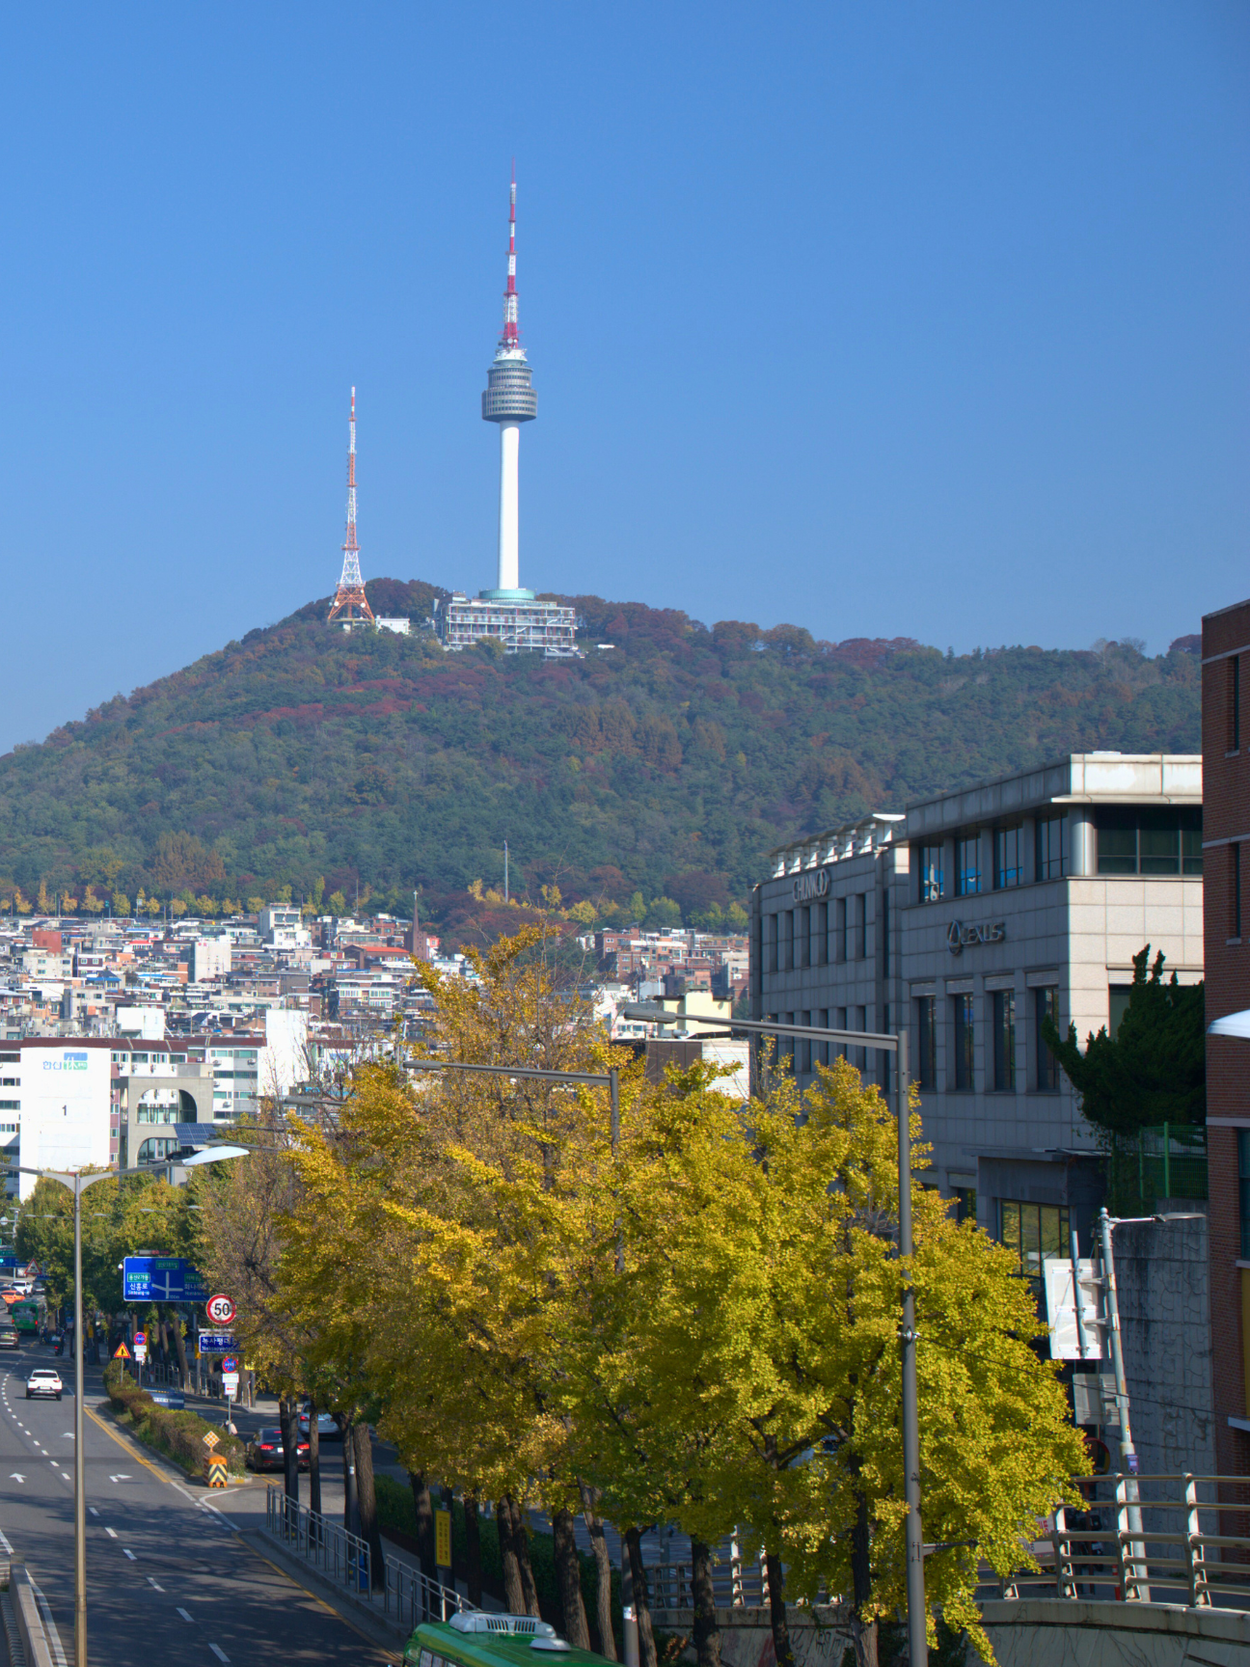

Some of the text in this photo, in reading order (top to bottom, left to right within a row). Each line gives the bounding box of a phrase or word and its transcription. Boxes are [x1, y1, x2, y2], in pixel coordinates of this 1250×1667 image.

[961, 923, 1004, 945] LEXUS
[43, 1061, 62, 1070] 한신
[62, 1105, 67, 1116] 1
[129, 1283, 148, 1291] 신흥로
[214, 1303, 230, 1316] 50
